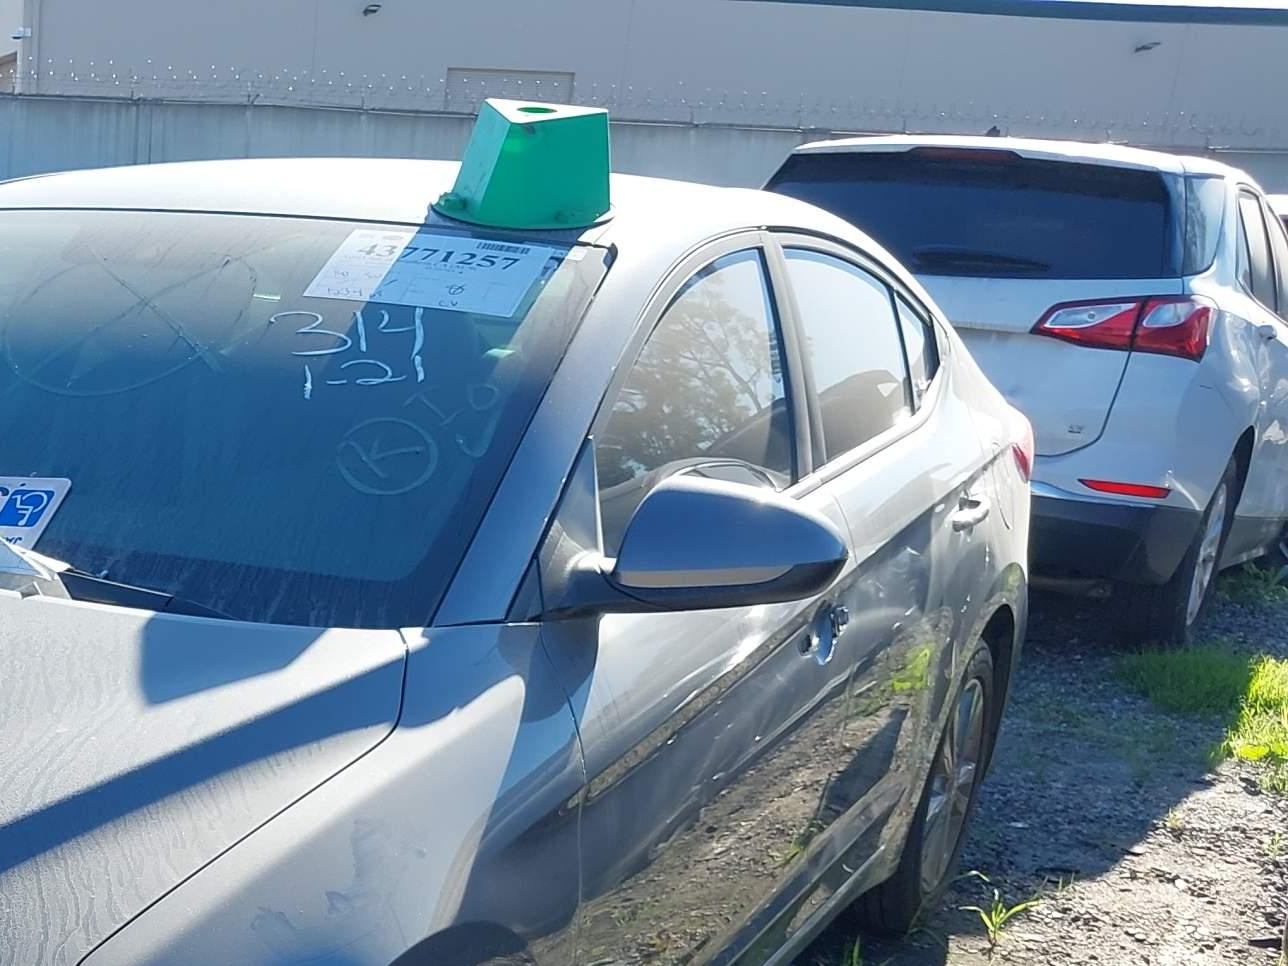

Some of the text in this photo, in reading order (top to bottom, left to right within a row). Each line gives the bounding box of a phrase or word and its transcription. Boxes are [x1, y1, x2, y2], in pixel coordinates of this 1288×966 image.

[357, 243, 520, 271] 43771257
[270, 307, 425, 360] 314
[303, 355, 425, 400] 1-21
